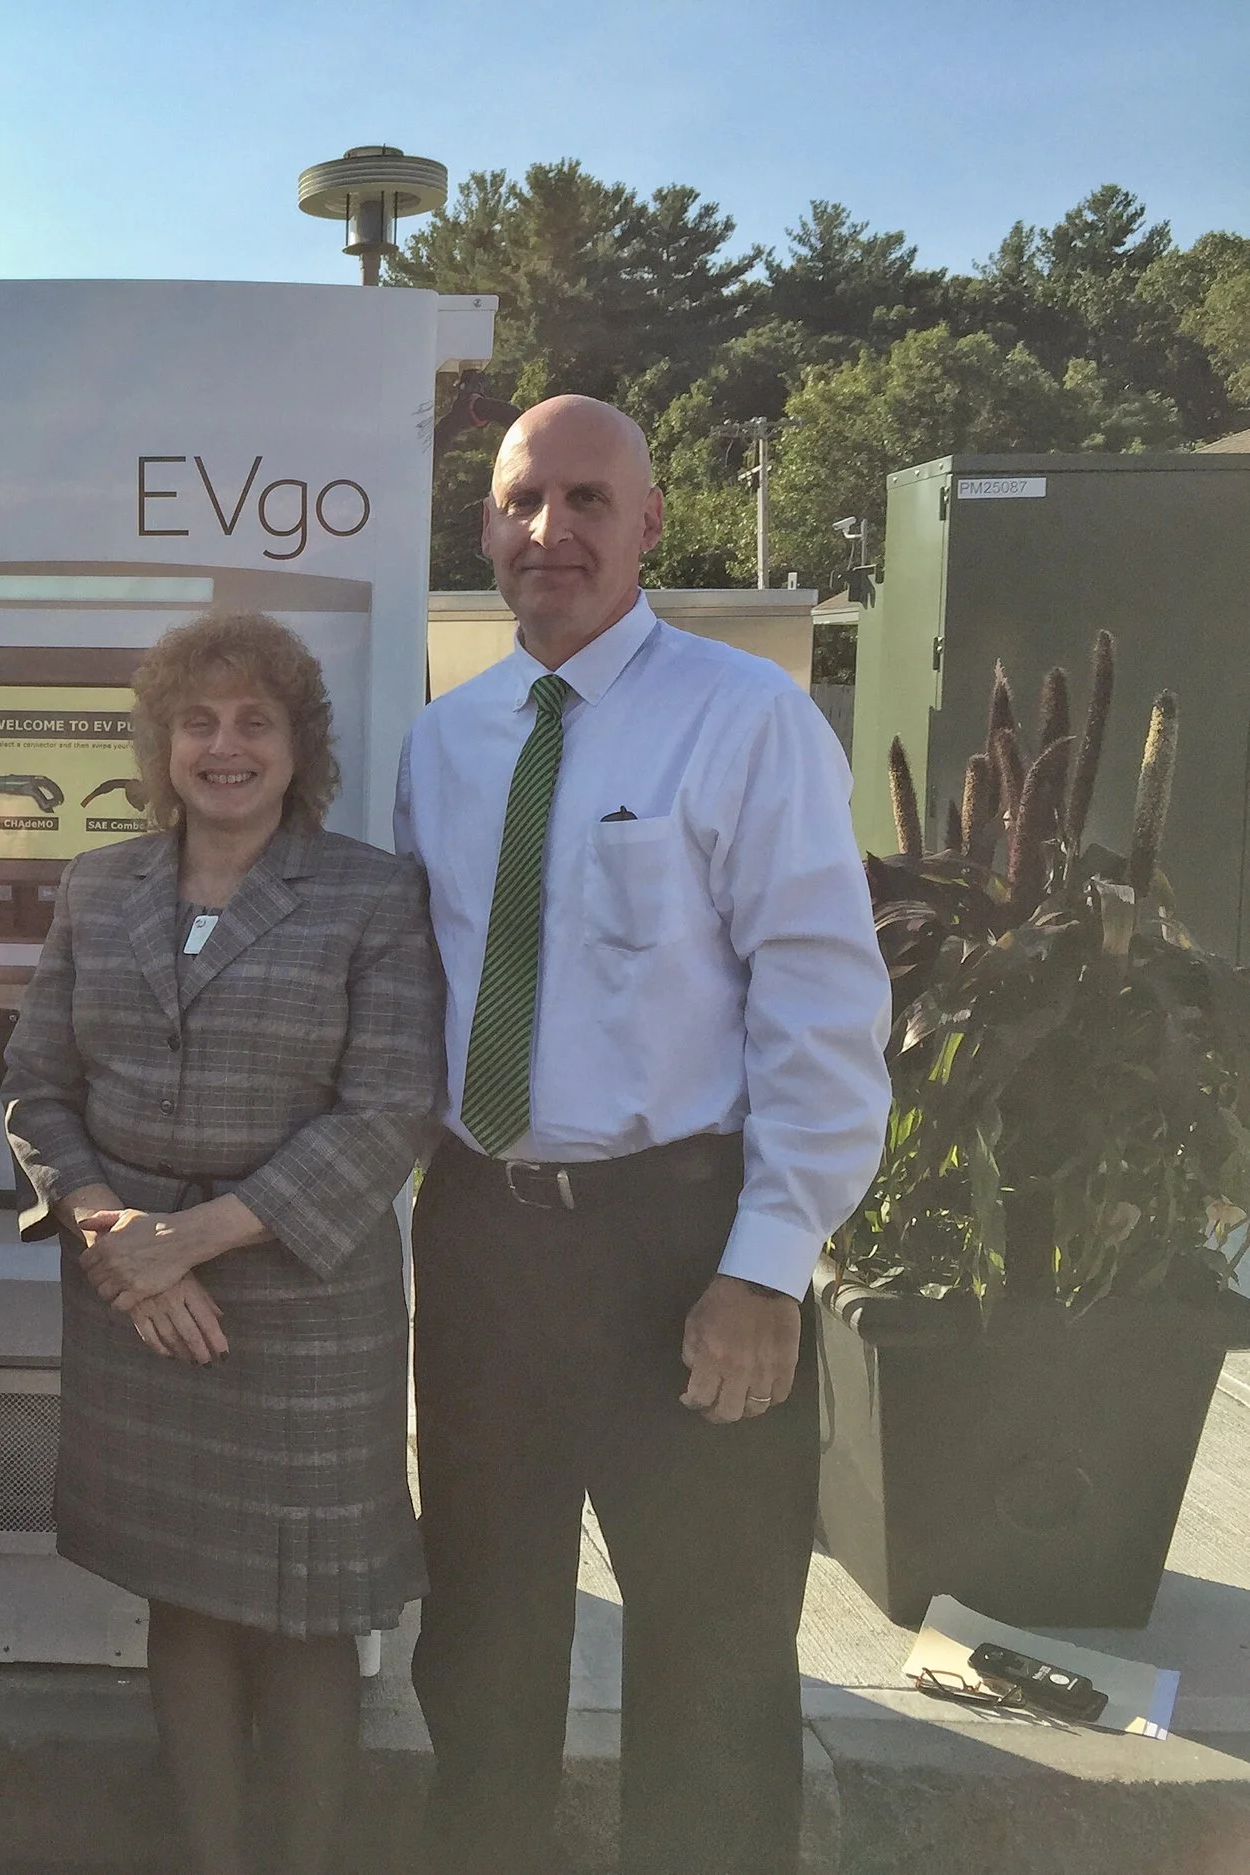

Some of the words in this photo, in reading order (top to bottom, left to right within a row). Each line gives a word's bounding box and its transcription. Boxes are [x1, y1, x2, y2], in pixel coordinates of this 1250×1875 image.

[959, 481, 1028, 494] PM25087
[138, 456, 370, 560] EVgo
[69, 720, 89, 732] TO
[94, 721, 113, 732] EV
[23, 741, 57, 749] connector
[4, 819, 54, 829] CHAdeMO
[88, 821, 108, 830] SAE
[111, 821, 145, 830] Combo
